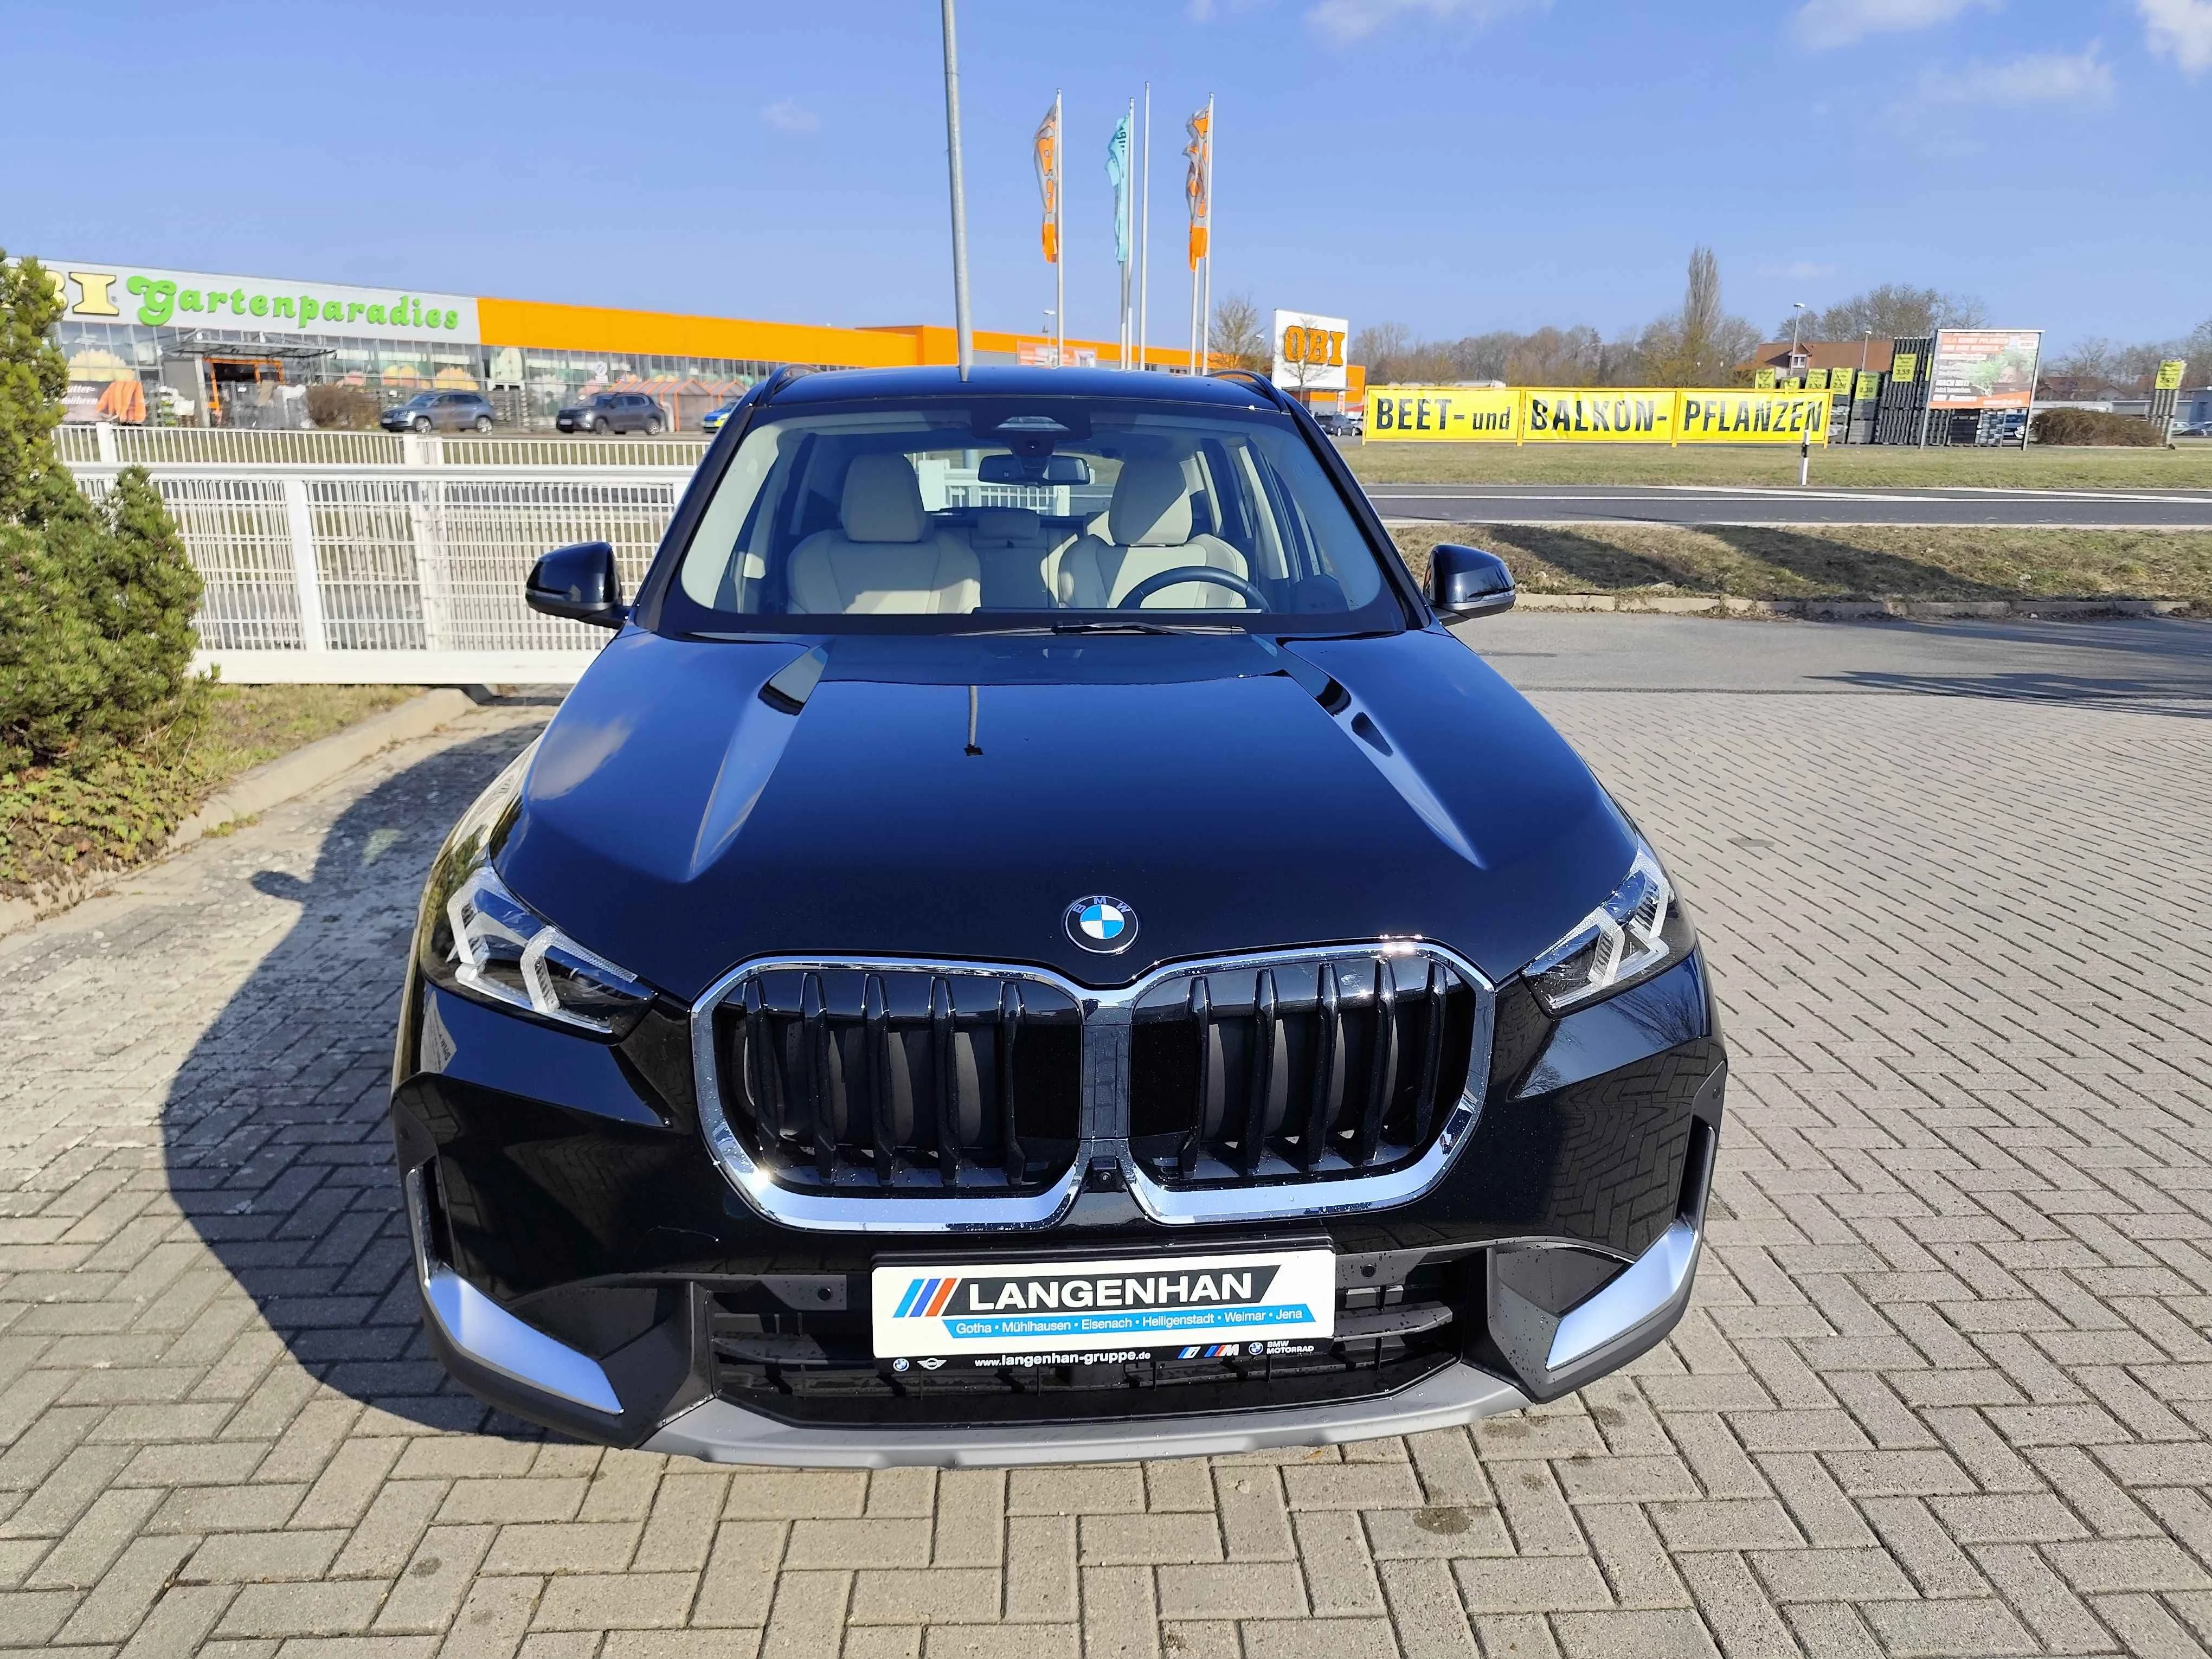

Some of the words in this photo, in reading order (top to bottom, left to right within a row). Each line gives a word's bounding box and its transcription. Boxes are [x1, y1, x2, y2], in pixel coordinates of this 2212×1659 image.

[126, 275, 458, 330] Gartenparadies
[1284, 325, 1345, 366] OBI
[1376, 398, 1465, 430] BEET-
[1472, 407, 1510, 430] und
[1531, 399, 1667, 432] BALKON-
[1684, 400, 1823, 432] PFLANZEN
[1072, 897, 1131, 914] BMW
[969, 1272, 1251, 1310] LANGENHAN
[956, 1322, 992, 1334] Gotha
[1002, 1321, 1071, 1333] Mühlhausen
[1081, 1317, 1132, 1330] Eisenach
[1142, 1313, 1214, 1328] Heiligenstadt
[1224, 1311, 1266, 1323] Weimar
[1275, 1309, 1302, 1320] Jena
[974, 1352, 1150, 1368] www.langenhan-gruppe.de
[1266, 1345, 1315, 1354] MOTORRAD
